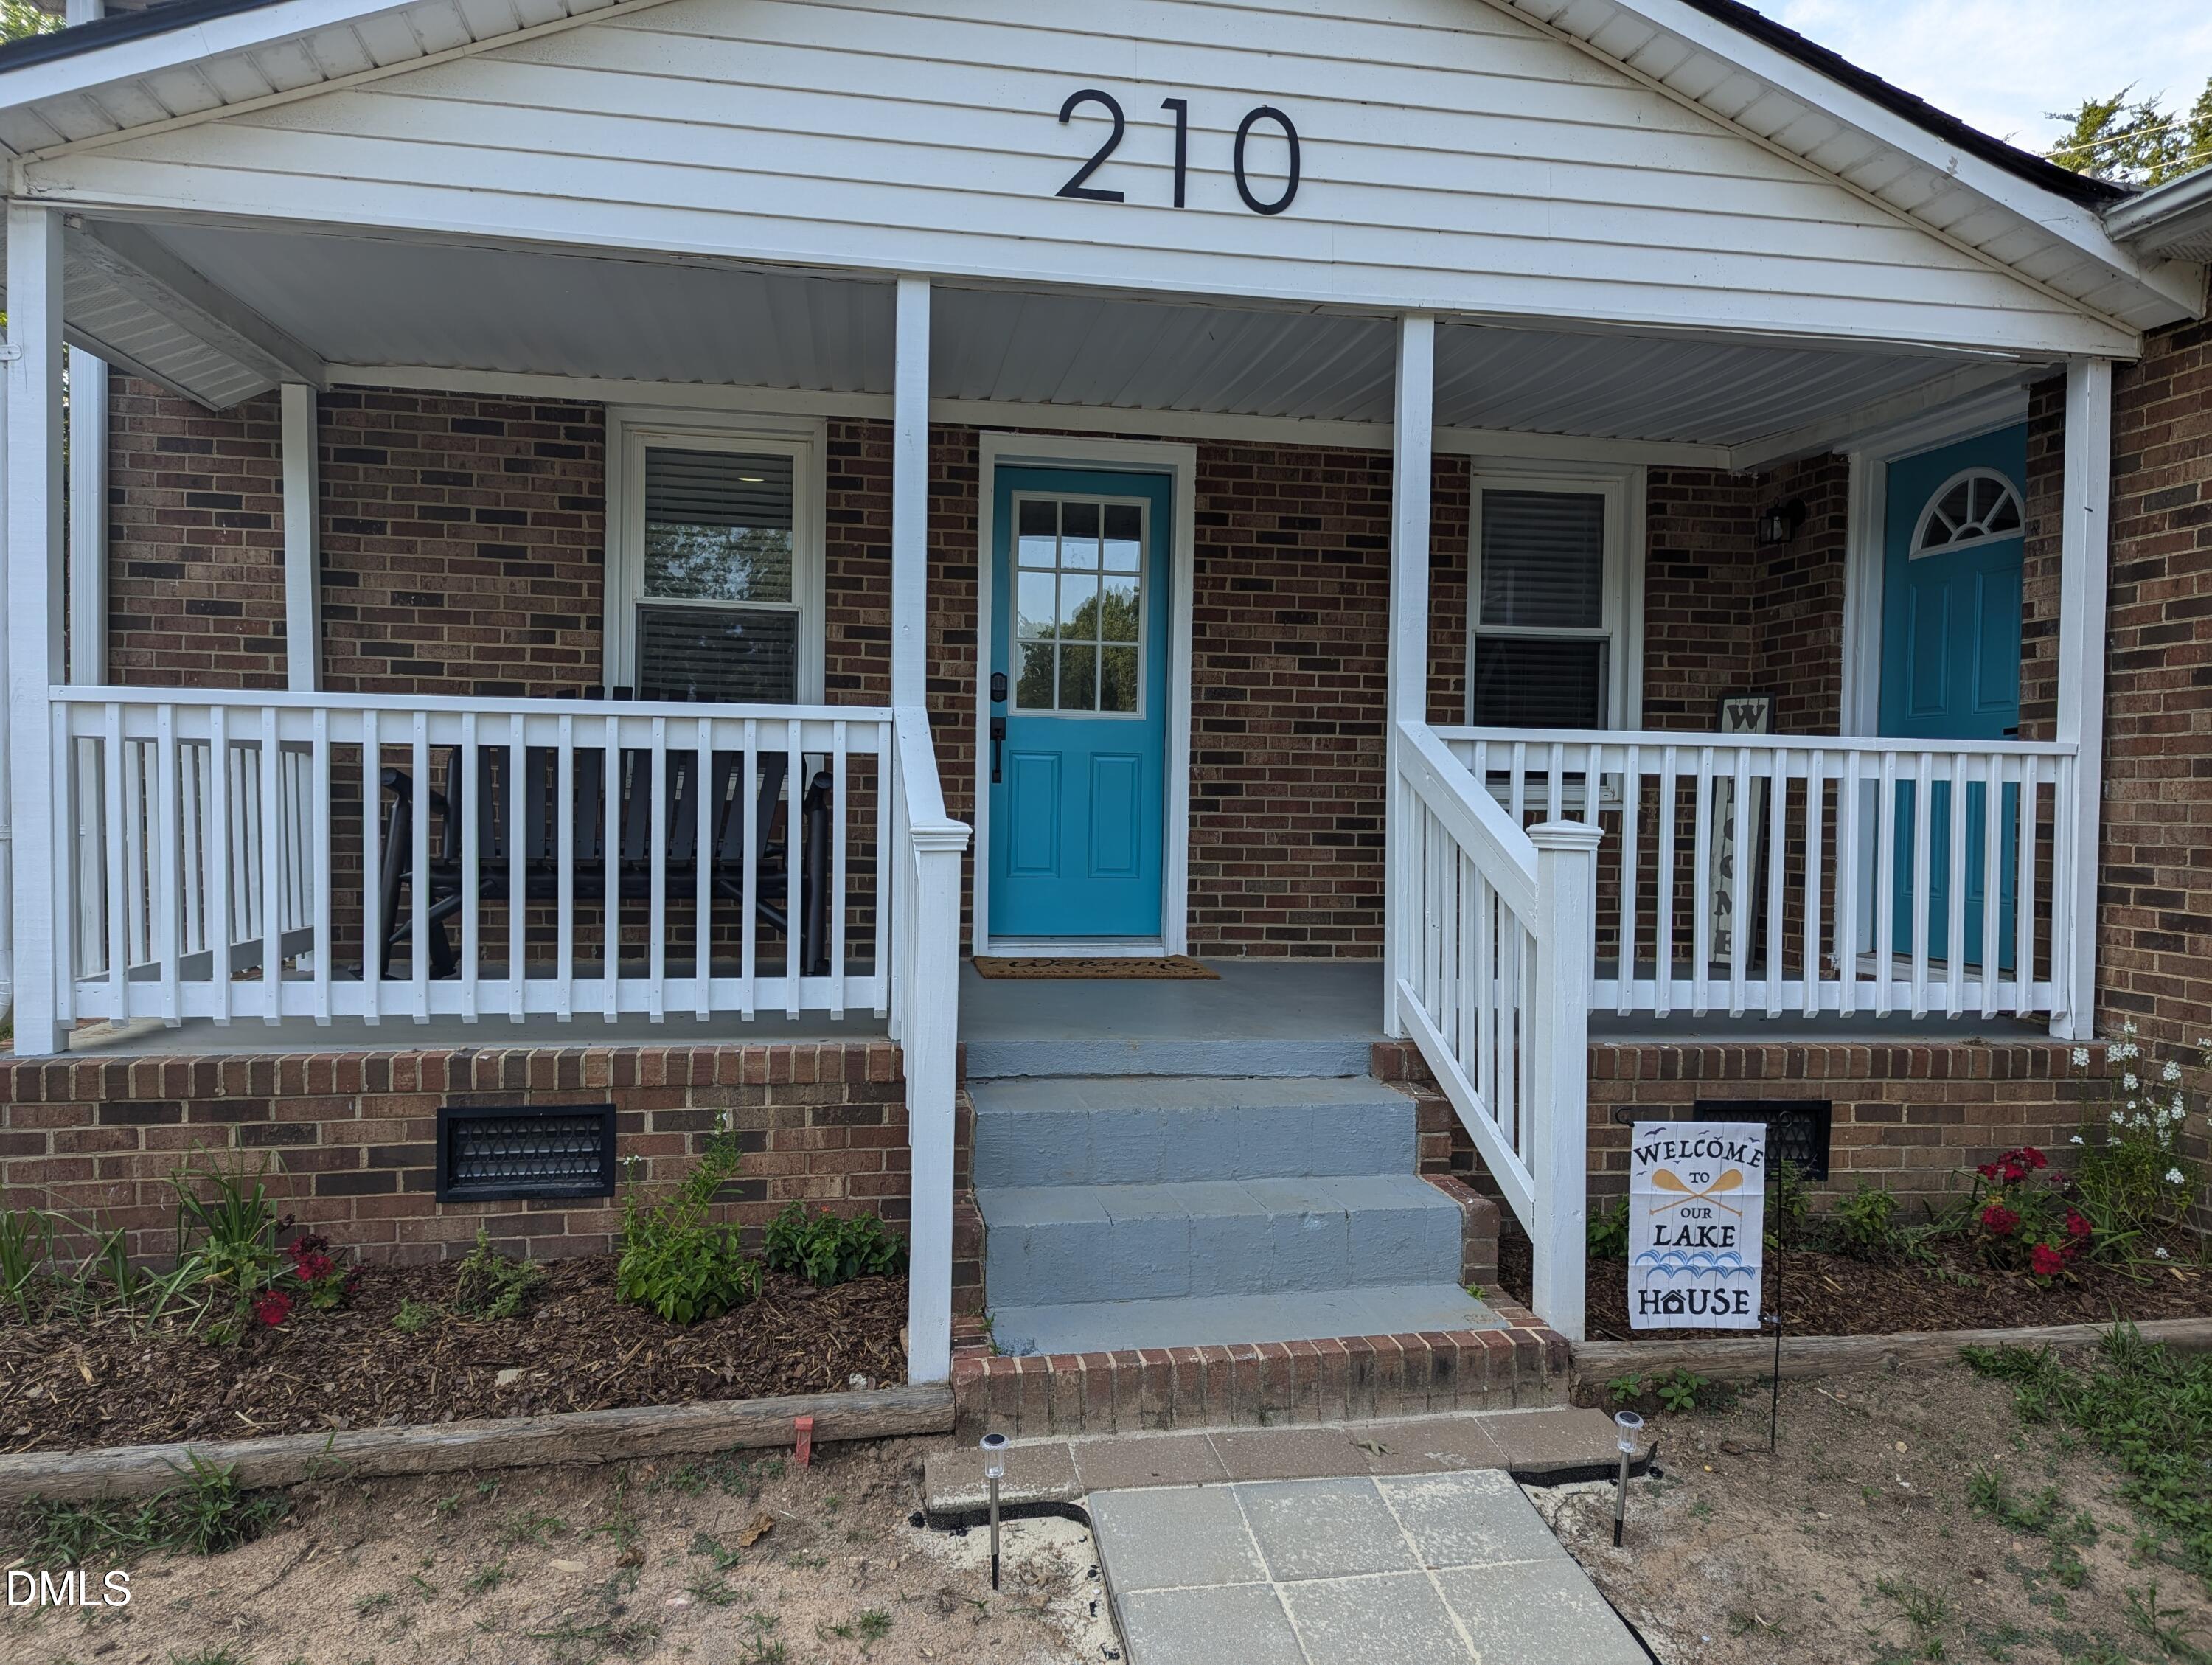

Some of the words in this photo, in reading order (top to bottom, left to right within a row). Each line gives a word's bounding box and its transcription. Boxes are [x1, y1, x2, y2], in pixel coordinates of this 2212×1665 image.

[1054, 89, 1300, 215] 210
[1633, 1139, 1764, 1168] WELCOME
[1689, 1172, 1710, 1183] TO
[1680, 1207, 1712, 1219] OUR
[1652, 1224, 1736, 1248] LAKE
